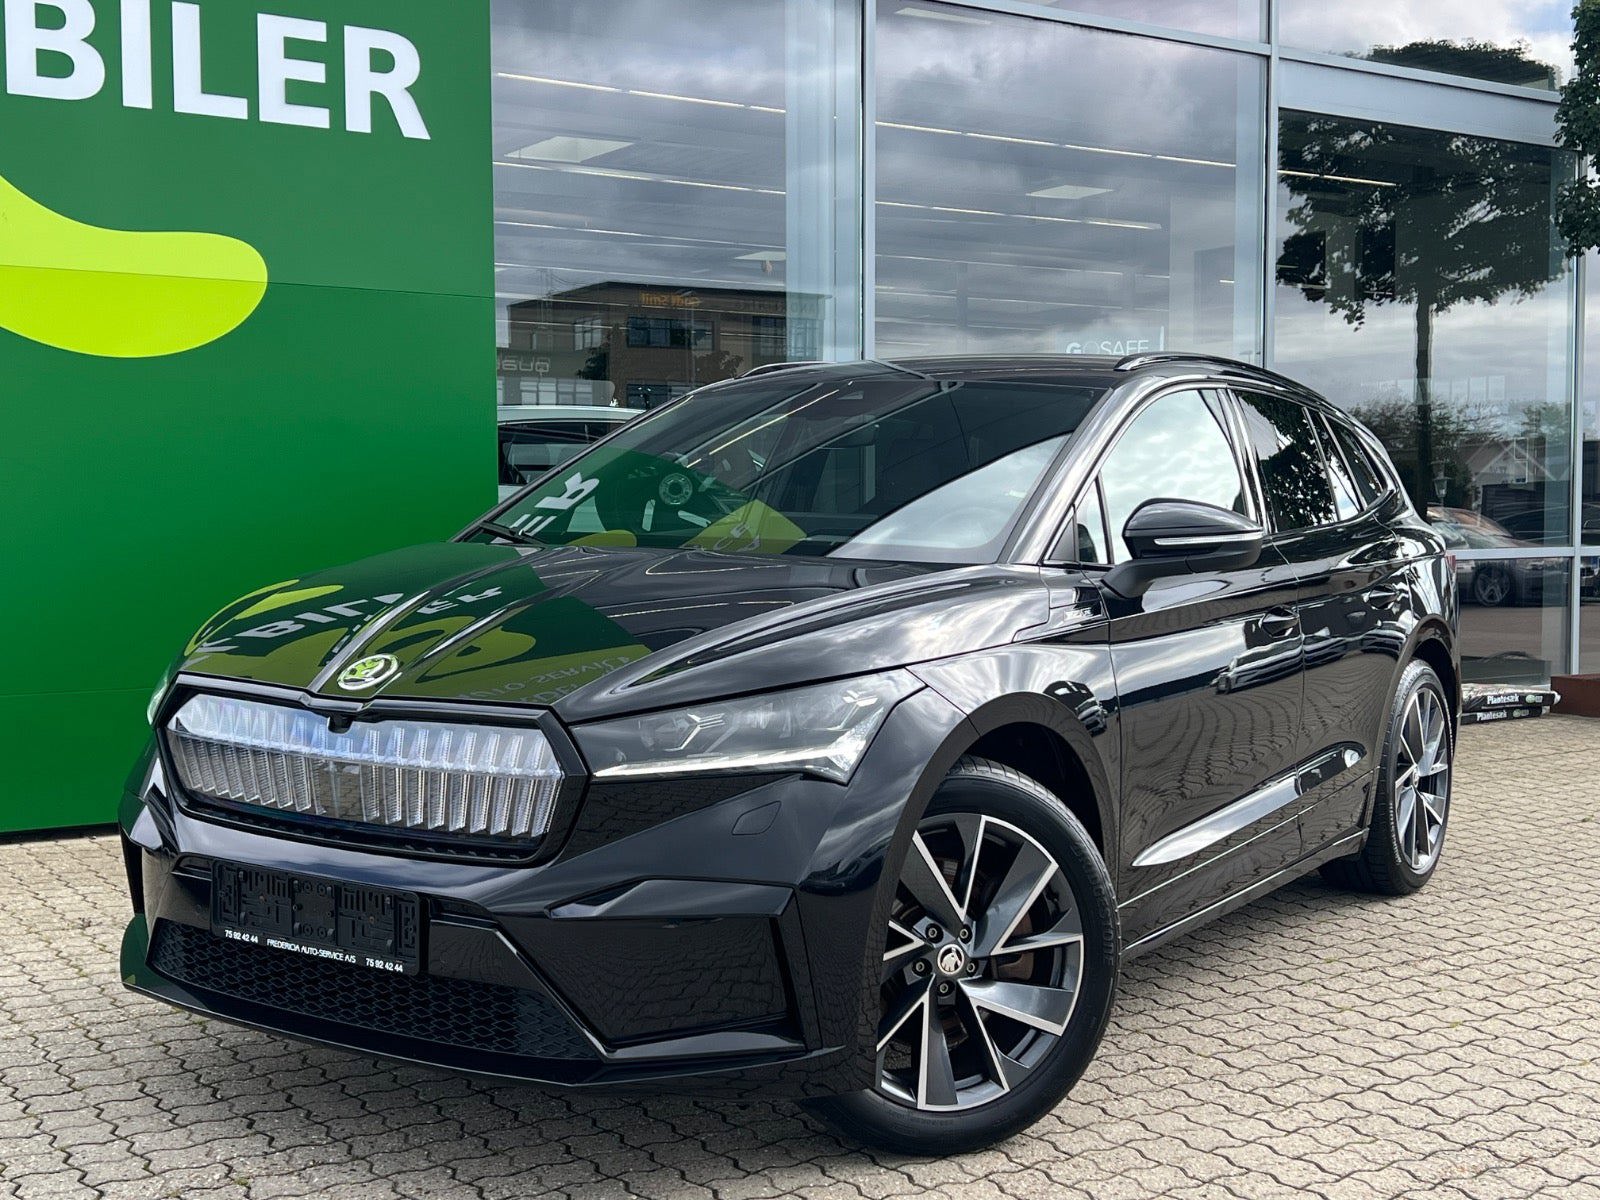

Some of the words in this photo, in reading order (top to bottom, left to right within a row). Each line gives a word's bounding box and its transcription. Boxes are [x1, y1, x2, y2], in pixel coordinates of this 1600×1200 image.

[4, 0, 432, 140] BILER
[224, 929, 233, 939] 75
[241, 933, 250, 942] 42
[250, 935, 259, 944] 44
[365, 957, 375, 967] 75
[374, 960, 384, 969] 92
[384, 962, 394, 971] 42
[394, 964, 404, 973] 44
